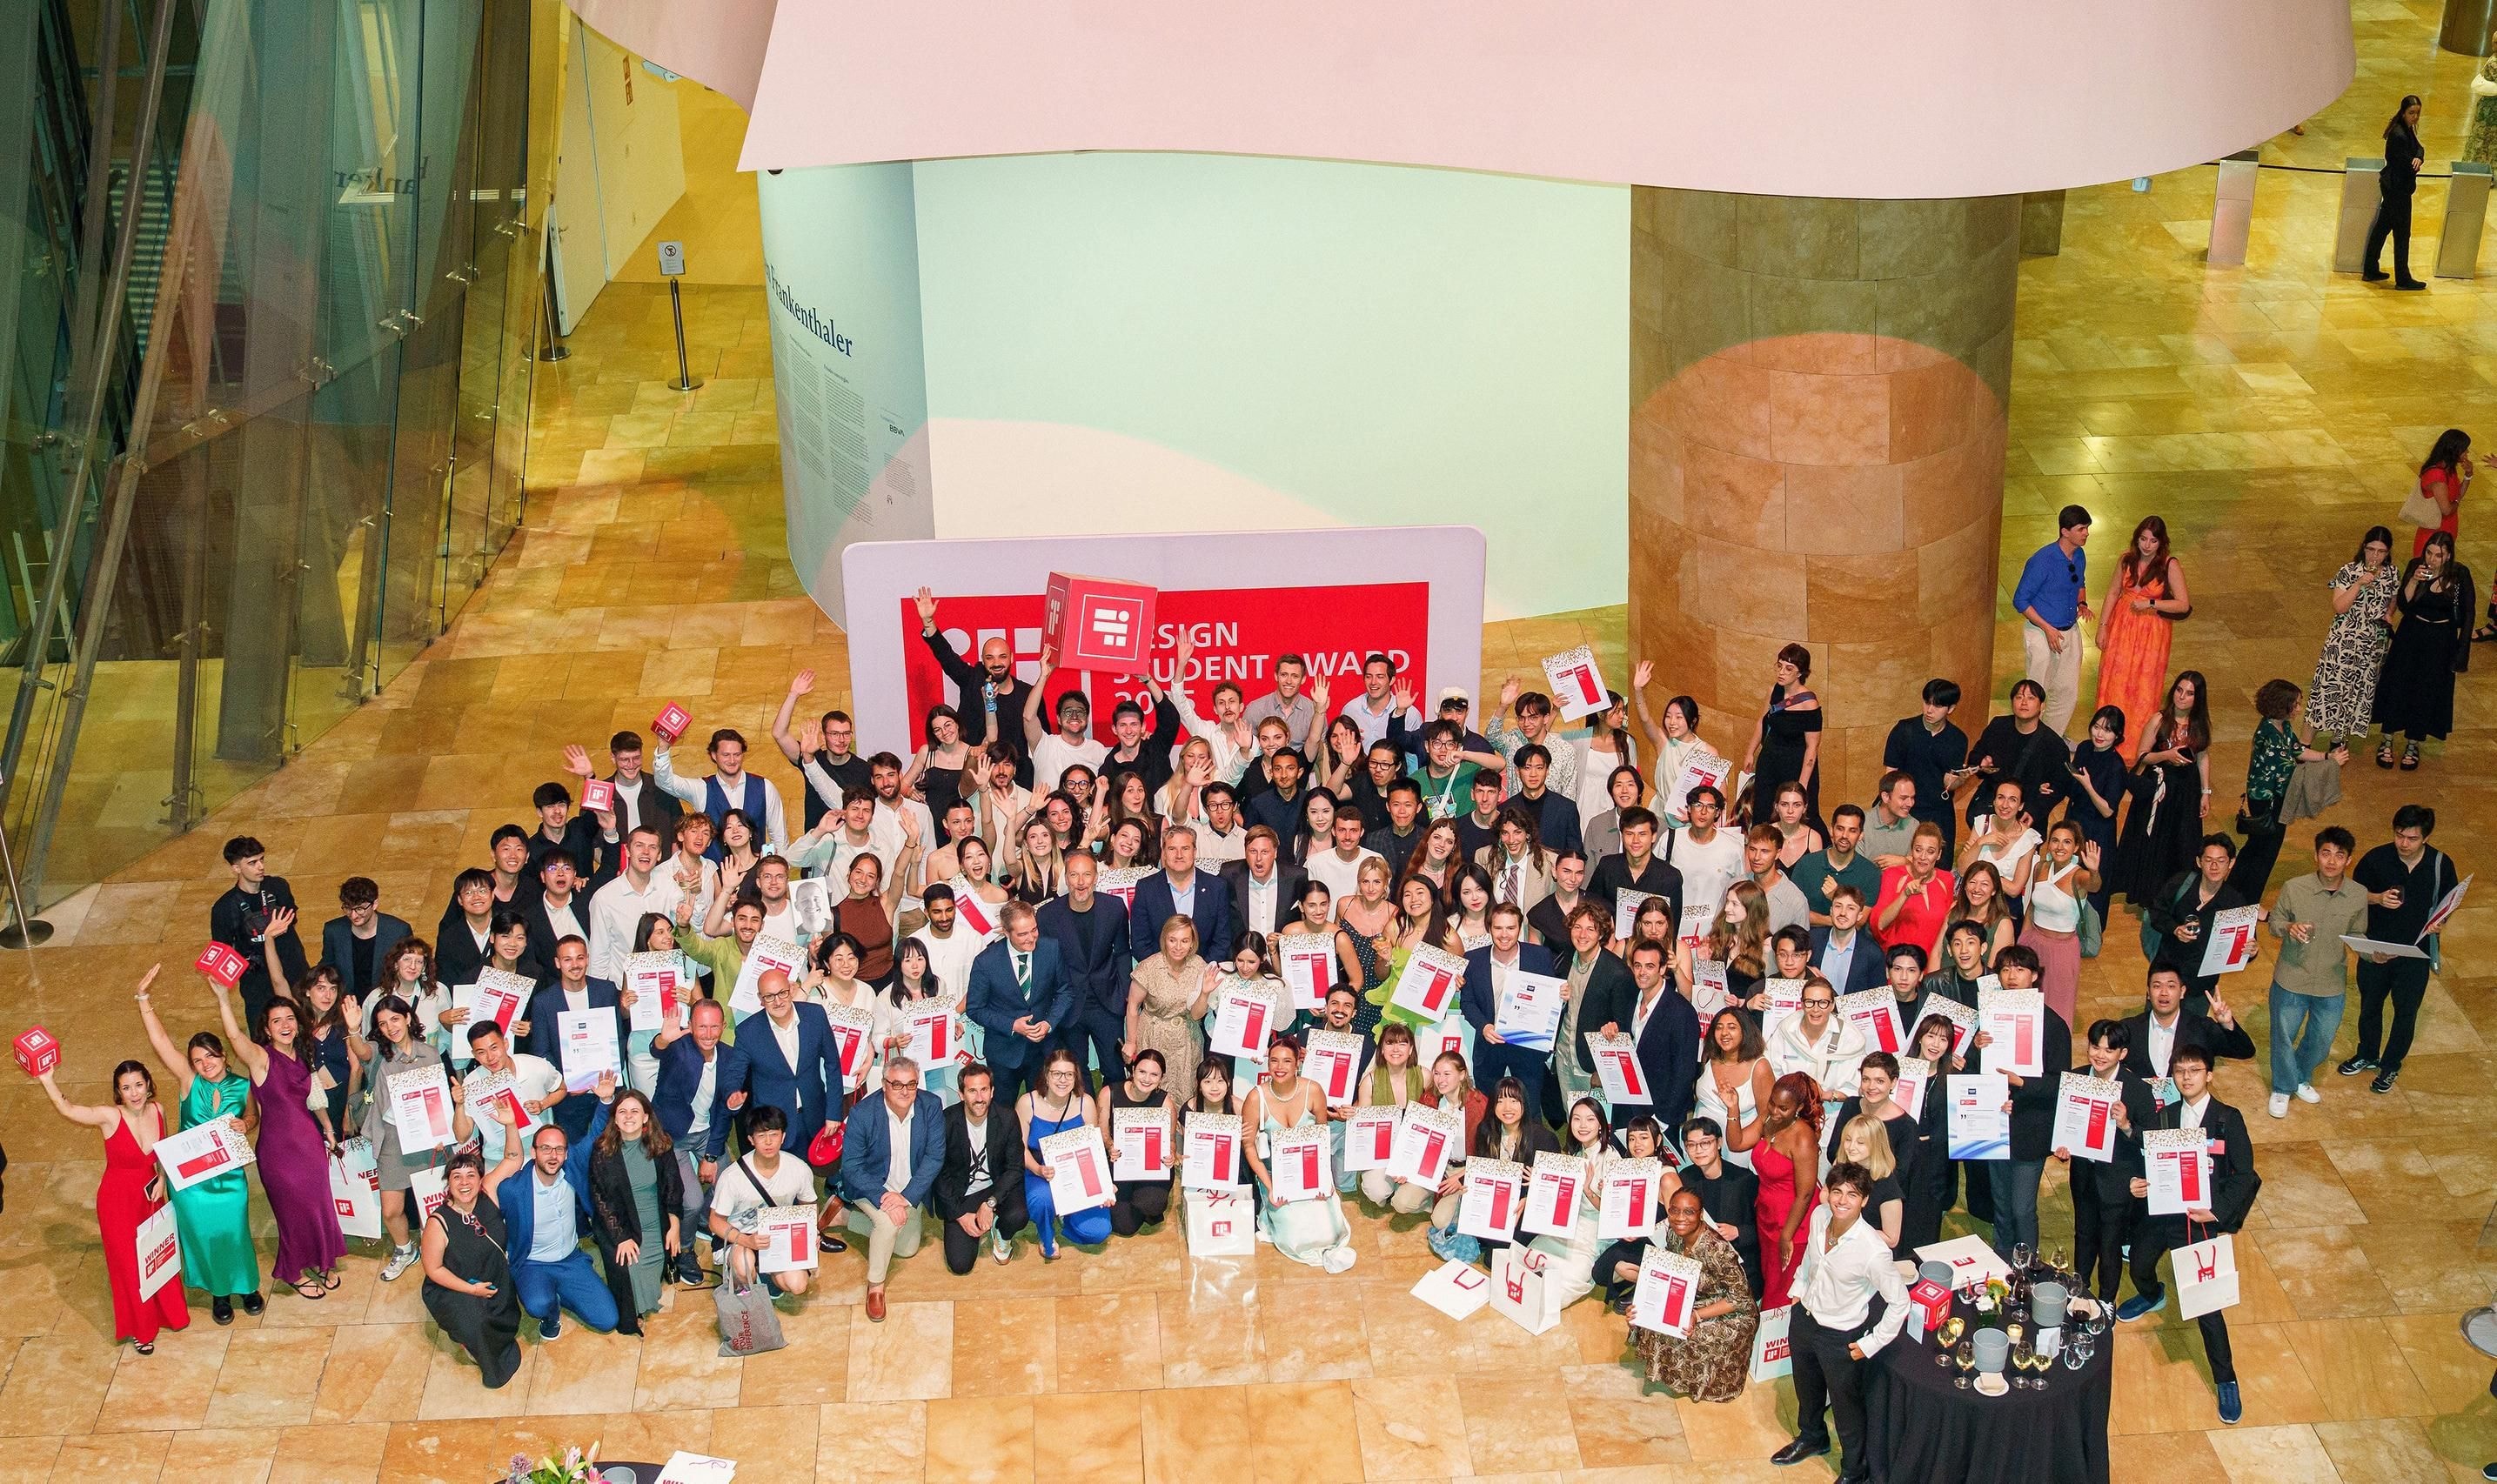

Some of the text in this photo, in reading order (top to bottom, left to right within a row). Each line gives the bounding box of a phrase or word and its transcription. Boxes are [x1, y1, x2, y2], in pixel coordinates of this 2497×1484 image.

[771, 264, 853, 358] Frankenthaler
[889, 424, 905, 437] BBVA
[1113, 649, 1410, 685] UDENT WAD
[338, 1201, 350, 1213] iF
[144, 1232, 175, 1264] WINNER
[741, 1310, 753, 1350] DIFFERENCE
